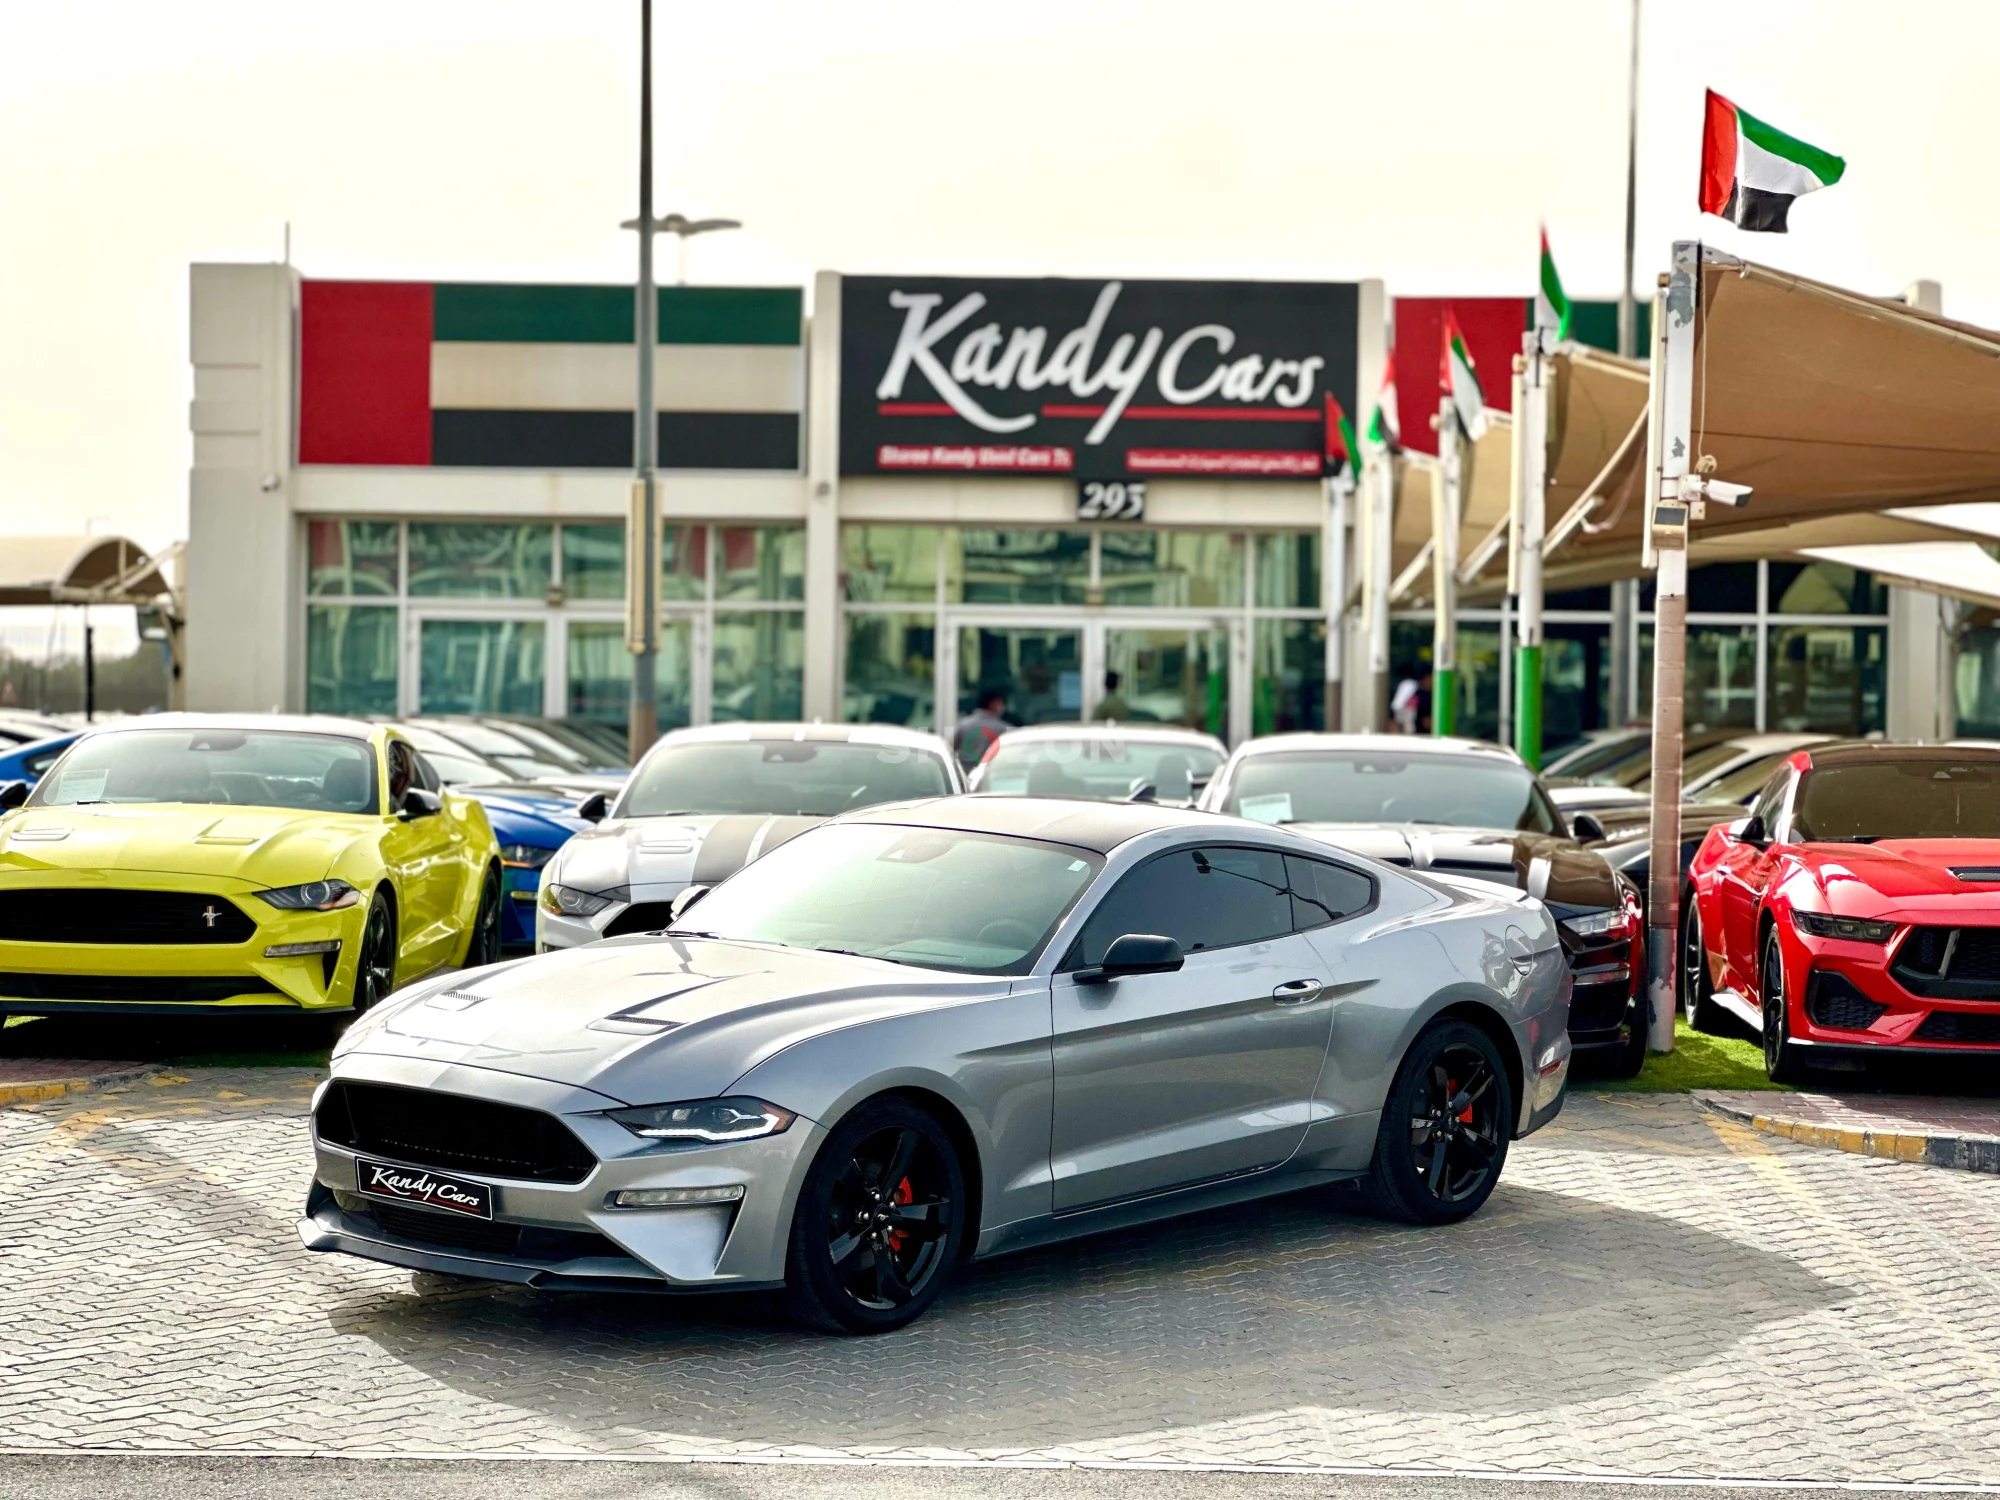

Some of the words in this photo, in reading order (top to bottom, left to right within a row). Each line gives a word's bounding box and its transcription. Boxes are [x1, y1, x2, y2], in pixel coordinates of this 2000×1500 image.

[877, 281, 1163, 444] Kandy
[1157, 325, 1325, 407] Cars
[371, 1166, 437, 1200] Kandy
[437, 1184, 480, 1206] Cars
